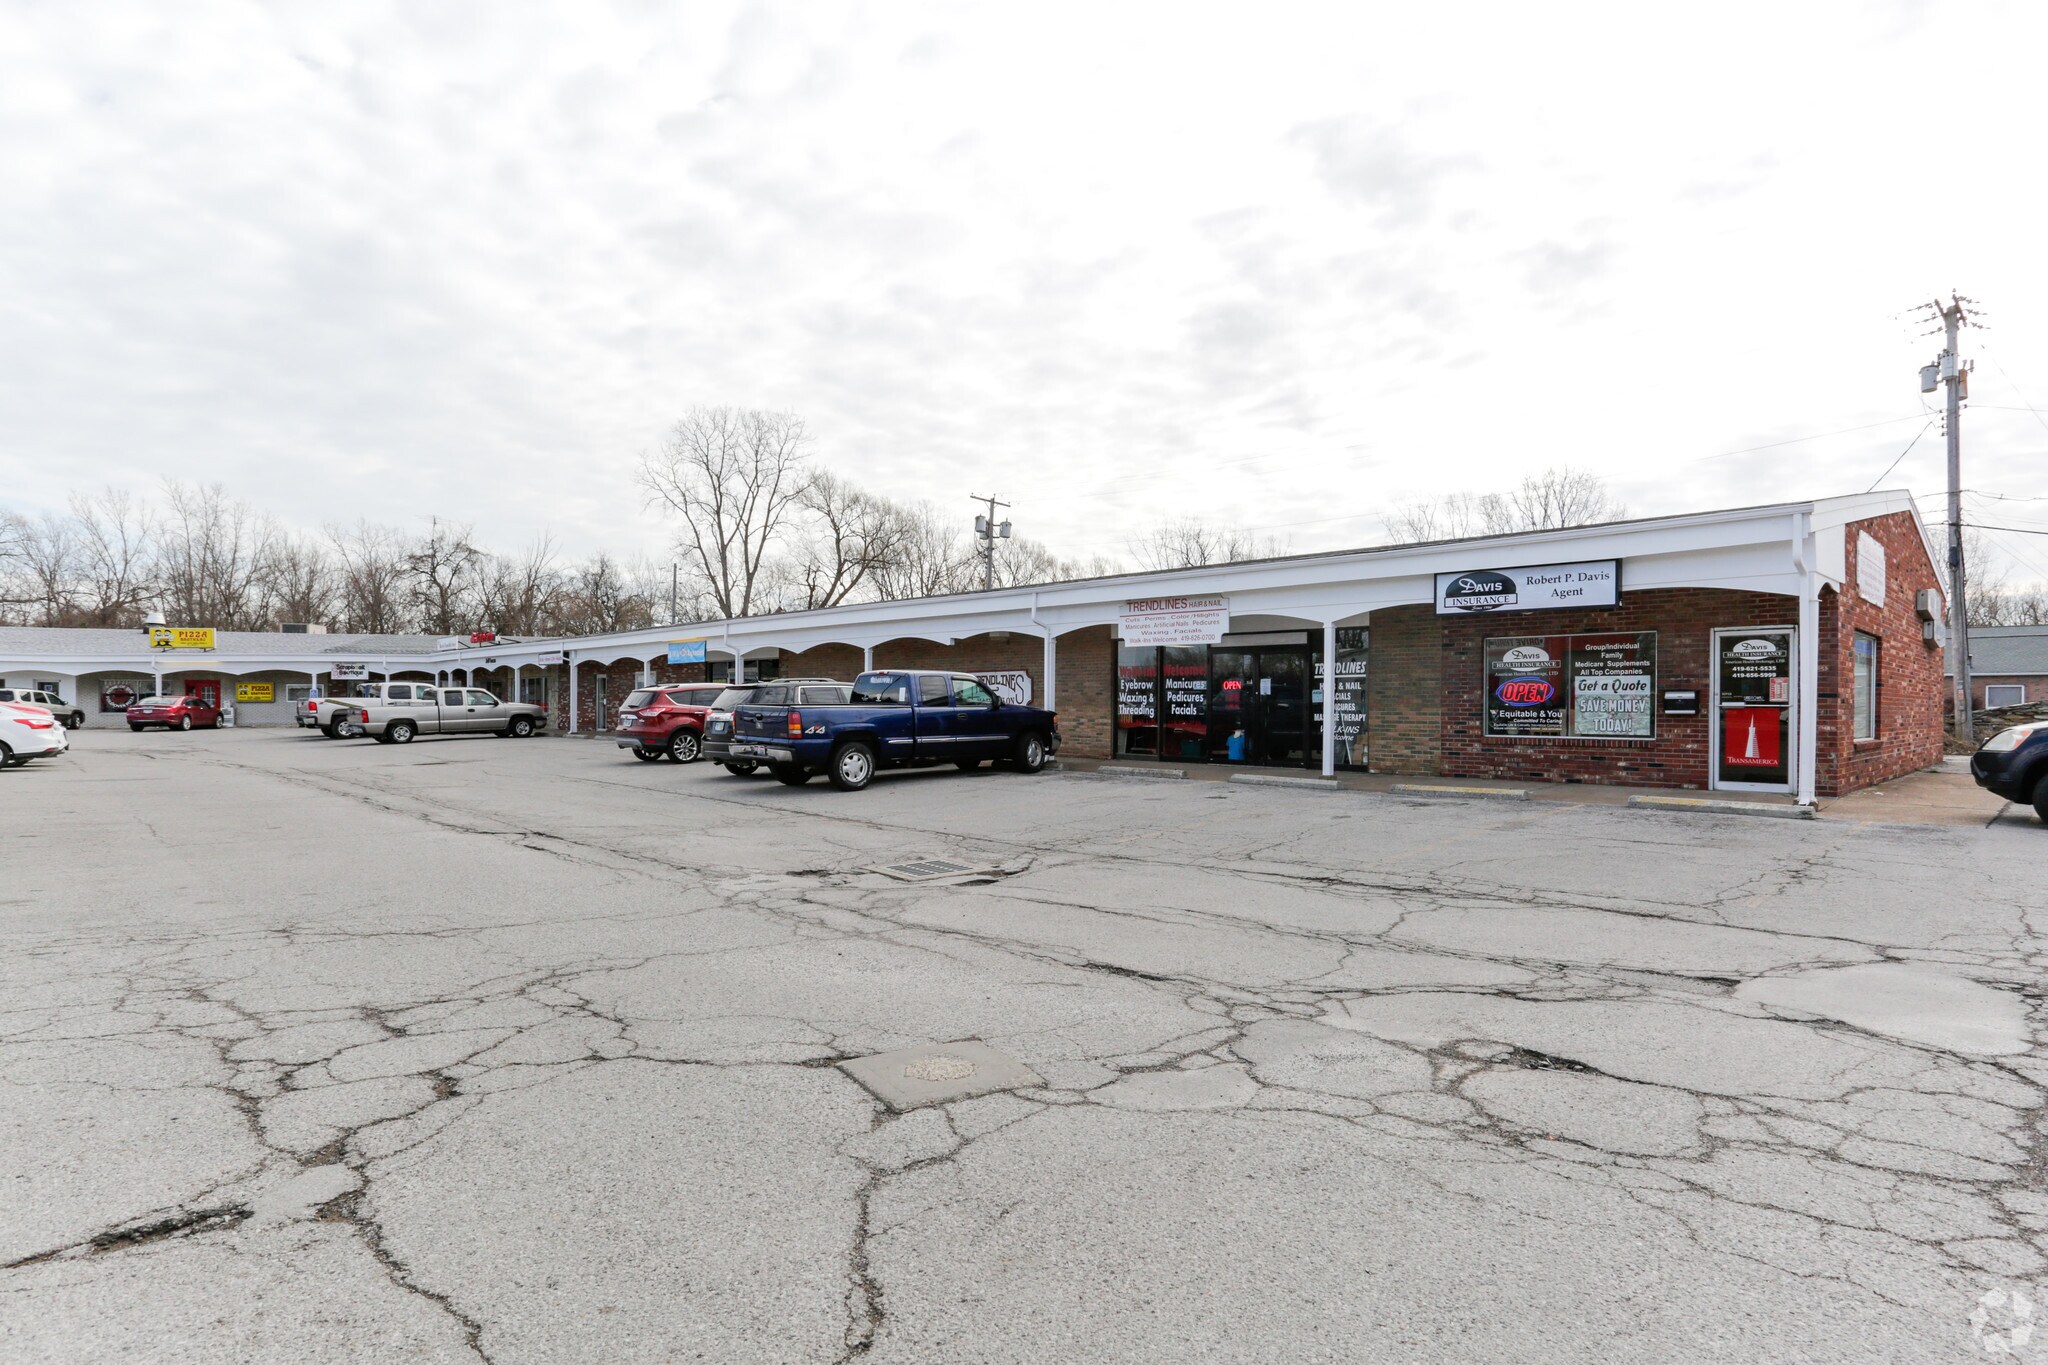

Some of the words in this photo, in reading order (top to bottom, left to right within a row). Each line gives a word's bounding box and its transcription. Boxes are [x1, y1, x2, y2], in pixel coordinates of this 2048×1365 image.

[1526, 574, 1562, 586] Robert
[1565, 573, 1575, 583] P.
[1578, 570, 1610, 582] Davis
[1458, 577, 1503, 593] DAVIS
[1550, 587, 1584, 600] Agent
[1127, 598, 1188, 612] TRENDLINES
[1188, 601, 1203, 609] HAIR
[1452, 594, 1510, 606] INSURANCE
[1175, 620, 1189, 628] Nails
[1192, 619, 1220, 627] Pedicures
[1585, 642, 1640, 651] Group/Individual
[1741, 642, 1768, 650] DAVIS
[1512, 649, 1541, 660] DAVIS
[1600, 651, 1623, 660] Family
[1315, 661, 1367, 675] TRDLINES
[1606, 660, 1651, 668] Supplements
[1591, 668, 1603, 676] Top
[1604, 668, 1643, 676] Companies
[1120, 679, 1153, 692] Eyebrow
[1165, 678, 1205, 689] Manicures
[1223, 680, 1242, 690] OPEN
[1345, 682, 1362, 690] NAIL
[1578, 679, 1599, 691] Get
[1600, 683, 1609, 691] a
[1611, 678, 1647, 694] Quote
[1167, 691, 1204, 702] Pedicures
[1502, 682, 1549, 703] OPEN
[1119, 692, 1147, 705] Waxing
[1148, 693, 1154, 702] &
[1119, 704, 1155, 718] Threading
[1171, 704, 1197, 715] Facials
[1580, 699, 1607, 713] SAVE
[1608, 698, 1646, 713] MONEY
[1341, 714, 1367, 722] THERAPY
[1499, 709, 1538, 719] Equitable
[1539, 710, 1546, 718] &
[1546, 710, 1563, 718] You
[1593, 718, 1633, 733] TODAY!
[1727, 756, 1779, 765] TRANSAMERICA
